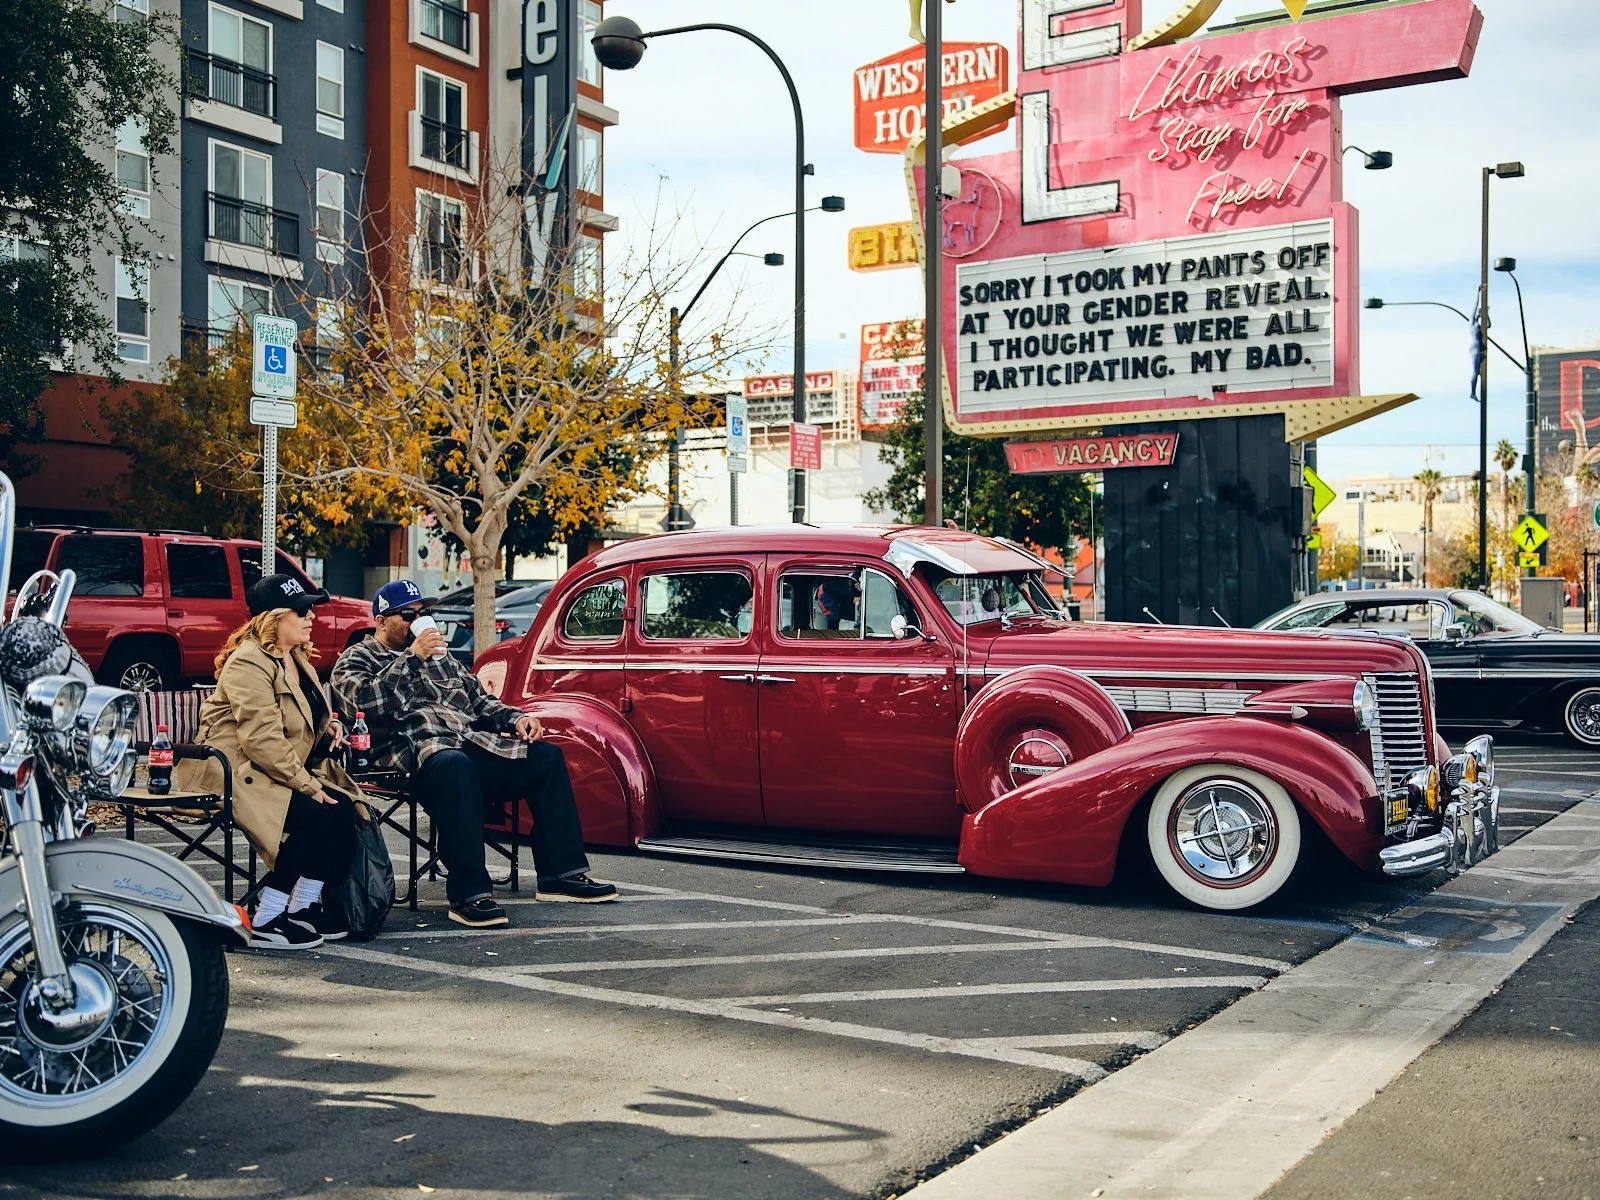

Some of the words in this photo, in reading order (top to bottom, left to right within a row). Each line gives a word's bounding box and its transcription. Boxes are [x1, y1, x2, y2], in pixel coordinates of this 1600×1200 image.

[1129, 36, 1307, 121] Llamas
[1148, 117, 1233, 162] Stay
[1243, 90, 1309, 150] for
[1185, 148, 1310, 224] Free!
[959, 276, 1035, 307] SORRY
[1044, 275, 1052, 297] I
[1057, 267, 1126, 296] TOOK
[1133, 262, 1171, 287] MY
[1181, 251, 1265, 282] PANTS
[1278, 243, 1330, 270] OFF
[959, 312, 989, 335] AT
[1003, 303, 1071, 330] YOUR
[1083, 291, 1188, 324] GENDER
[1206, 276, 1329, 311] REVEAL.
[257, 322, 294, 338] RESERVED
[260, 333, 292, 347] PARKING
[971, 341, 977, 363] I
[989, 329, 1114, 361] THOUGHT
[1126, 323, 1164, 348] WE
[1174, 315, 1249, 345] WERE
[1265, 308, 1319, 336] ALL
[871, 366, 899, 378] HAVE
[973, 355, 1175, 392] PARTICIPATING.
[1191, 348, 1232, 374] MY
[1246, 342, 1312, 370] BAD.
[749, 374, 832, 393] CASNO
[863, 380, 891, 392] WITH
[1540, 416, 1559, 431] the
[1053, 438, 1169, 466] VACANCY
[402, 580, 419, 596] LA
